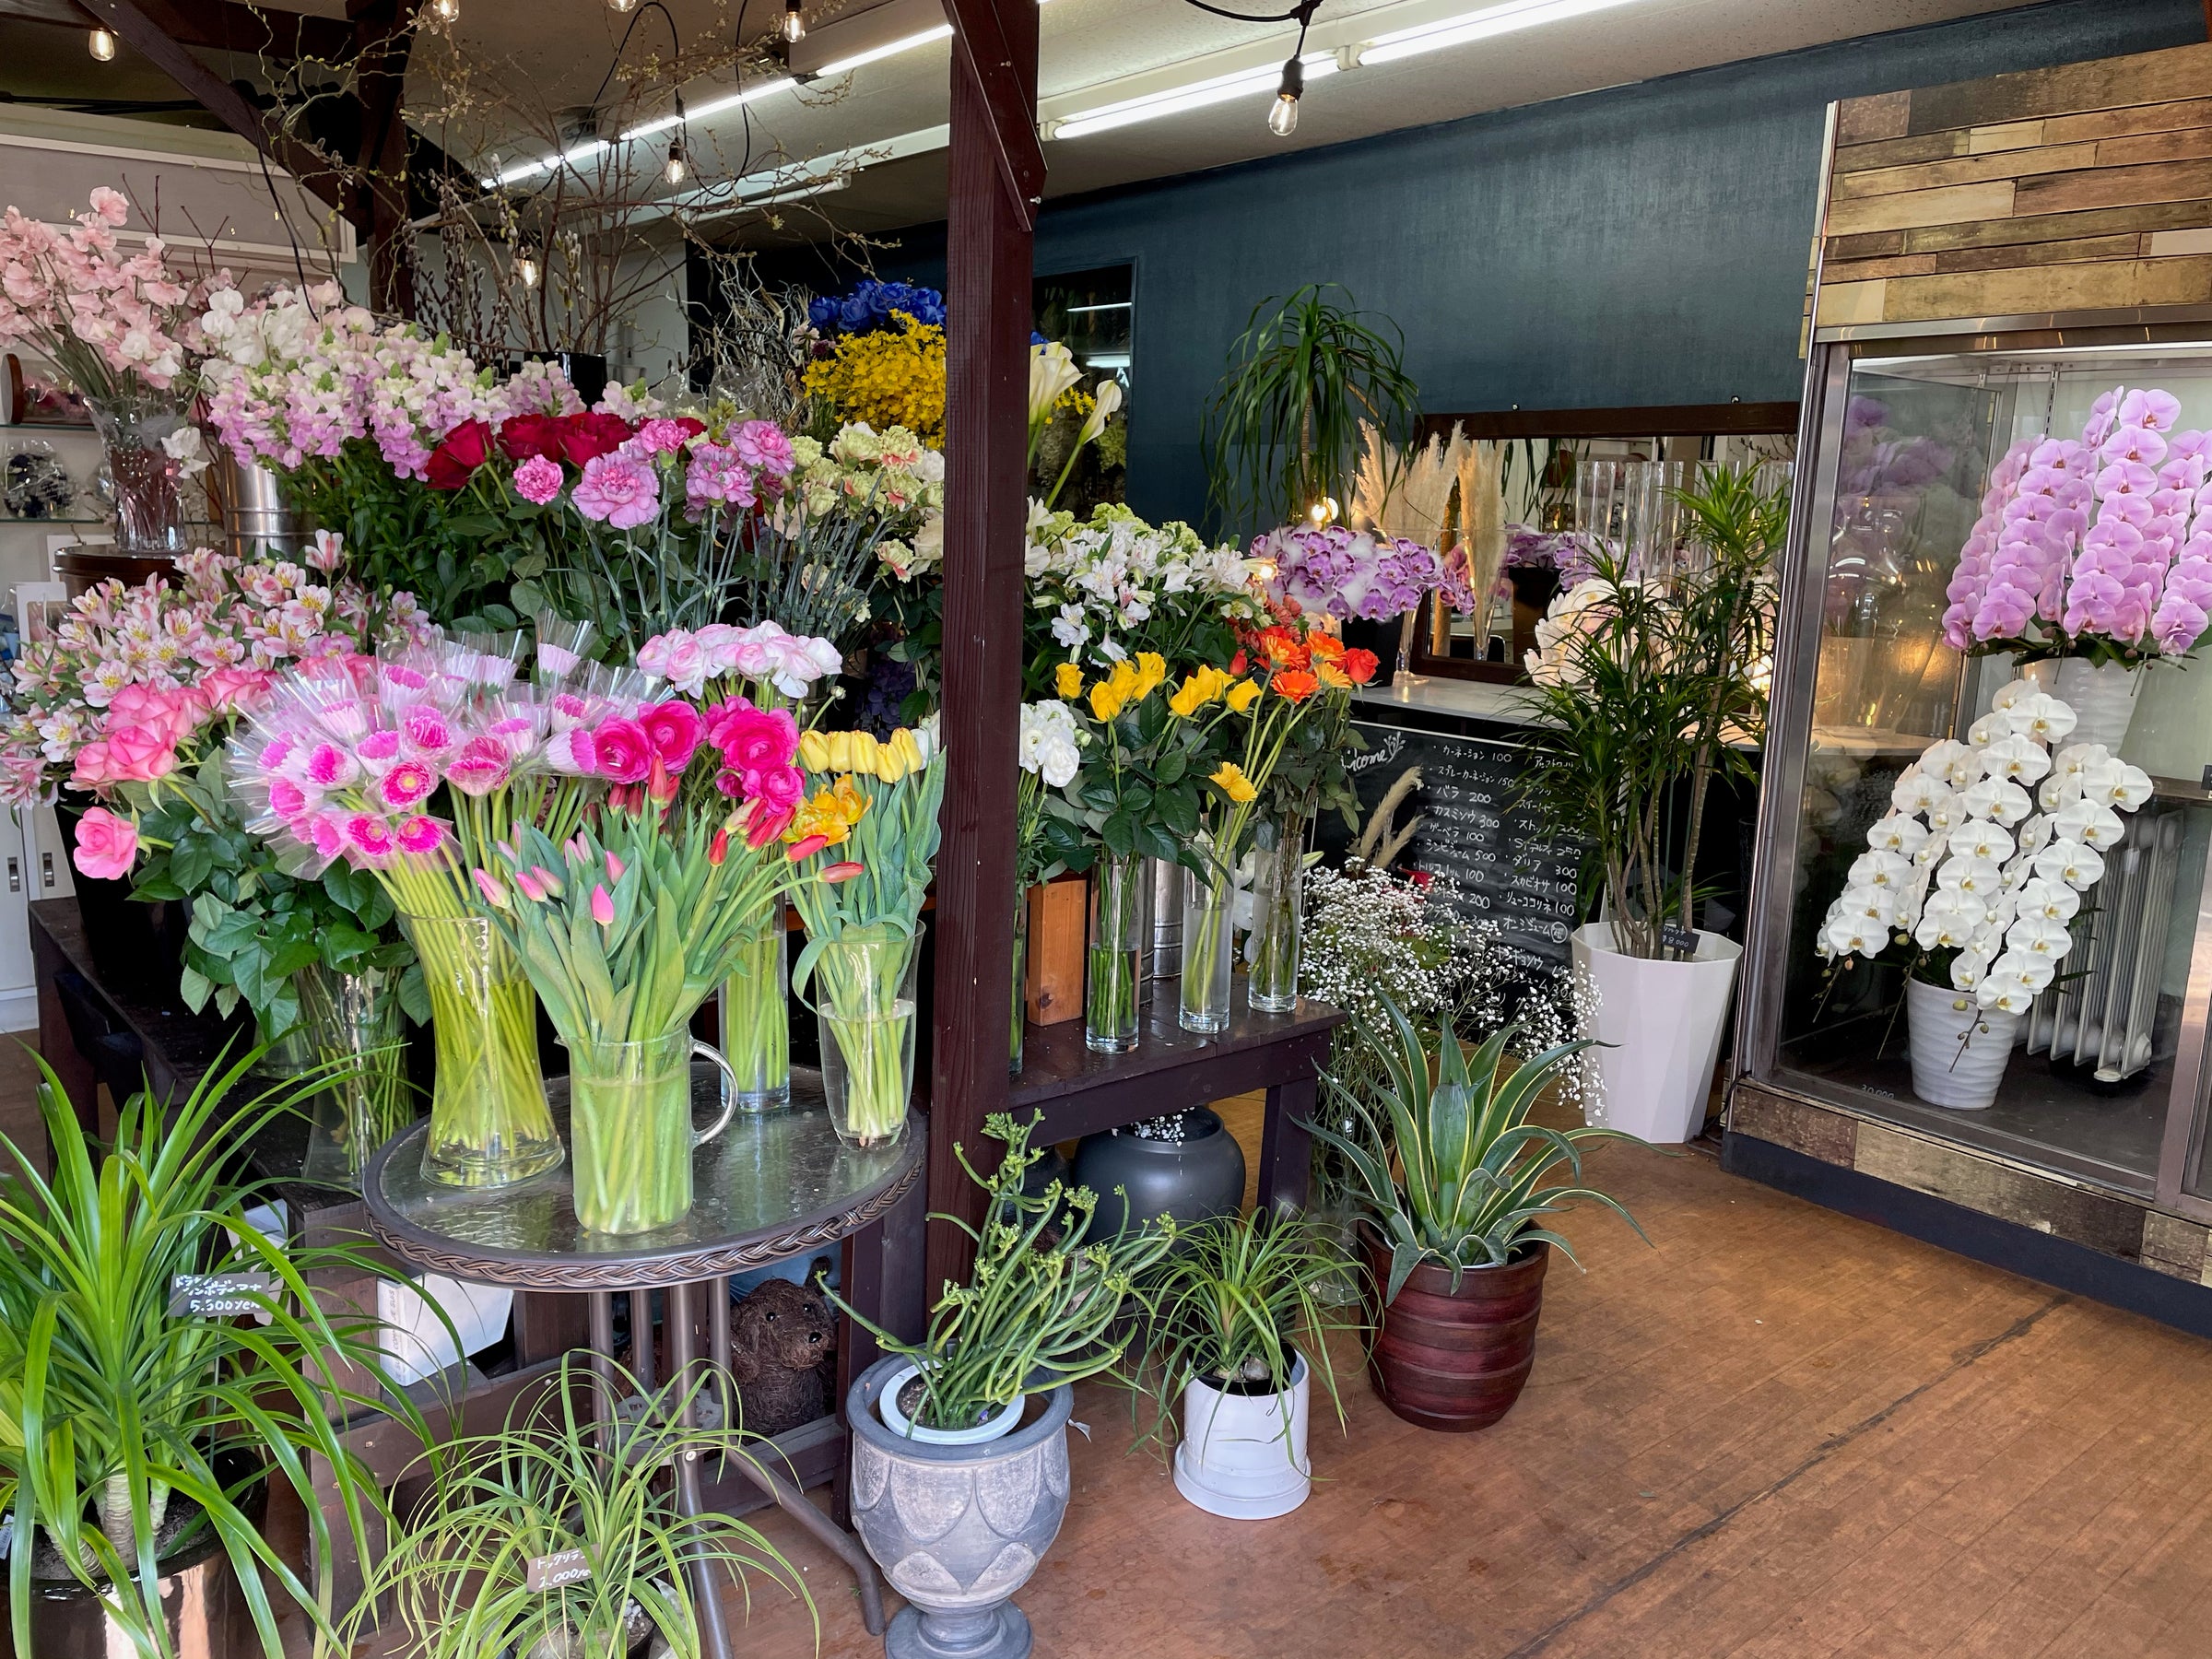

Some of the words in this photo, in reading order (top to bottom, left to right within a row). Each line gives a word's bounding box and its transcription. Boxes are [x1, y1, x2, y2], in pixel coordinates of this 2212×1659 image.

[1443, 745, 1485, 759] カーネーション
[1492, 752, 1512, 763] 100
[1438, 764, 1495, 783] スプレーカーネーション
[1498, 777, 1514, 788] 150
[1436, 784, 1460, 799] バラ
[1468, 792, 1492, 804] 200
[1433, 805, 1477, 824] カスミソウ
[1478, 814, 1500, 829] 300
[1465, 831, 1485, 842] 100
[1474, 849, 1497, 862] 500
[1512, 853, 1542, 872] ダリア
[1555, 865, 1578, 879] 300
[1465, 868, 1485, 883] 100
[1512, 875, 1550, 893] スカビオサ
[1555, 881, 1578, 896] 100
[1468, 892, 1491, 910] 200
[1555, 900, 1575, 917] 100
